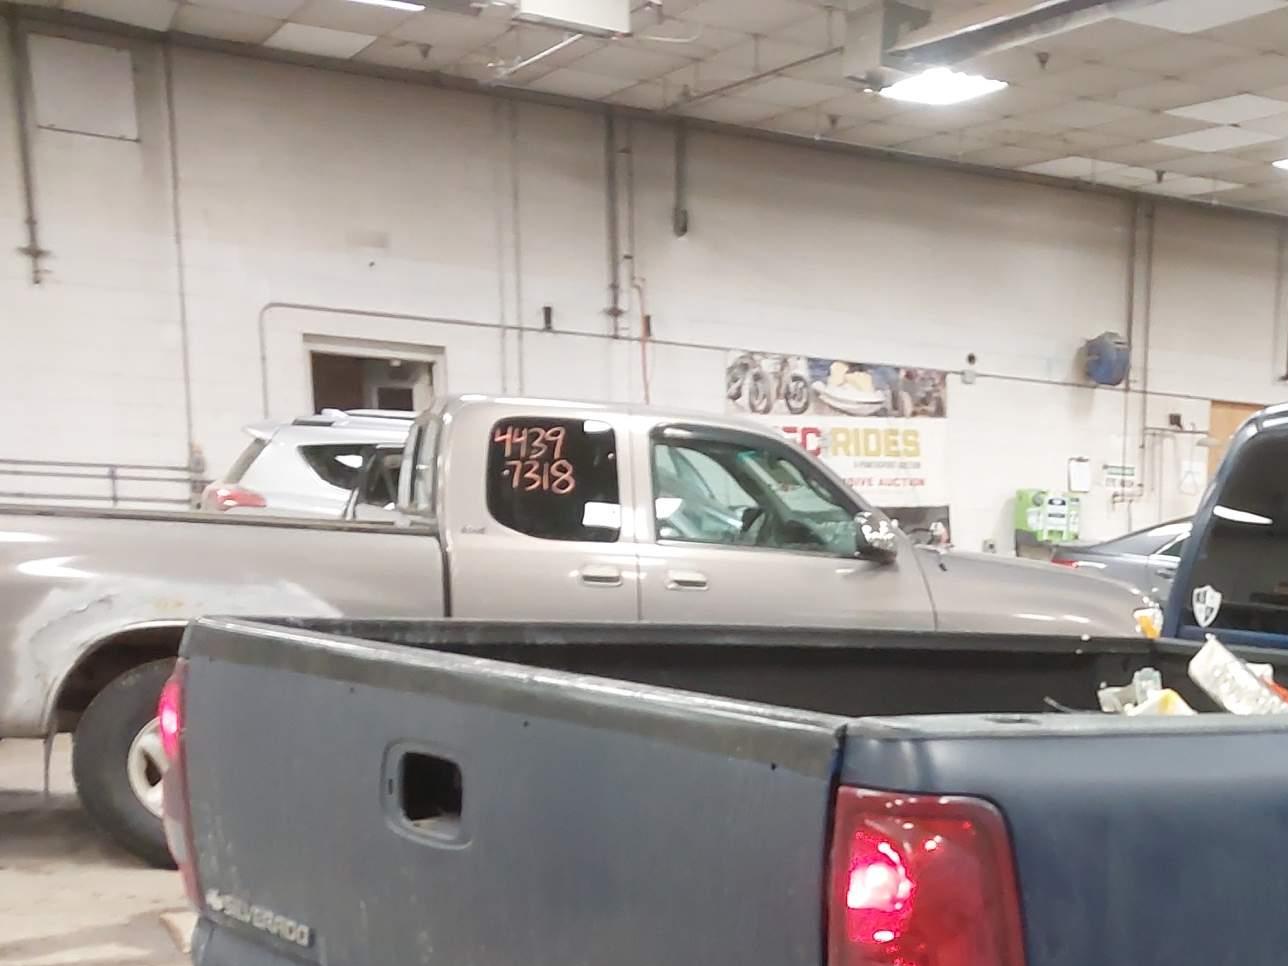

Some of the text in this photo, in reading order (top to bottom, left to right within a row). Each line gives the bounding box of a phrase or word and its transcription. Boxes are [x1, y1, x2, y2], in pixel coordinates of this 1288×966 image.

[494, 426, 566, 459] 4439
[831, 427, 921, 458] RIDES
[505, 459, 576, 494] 7318
